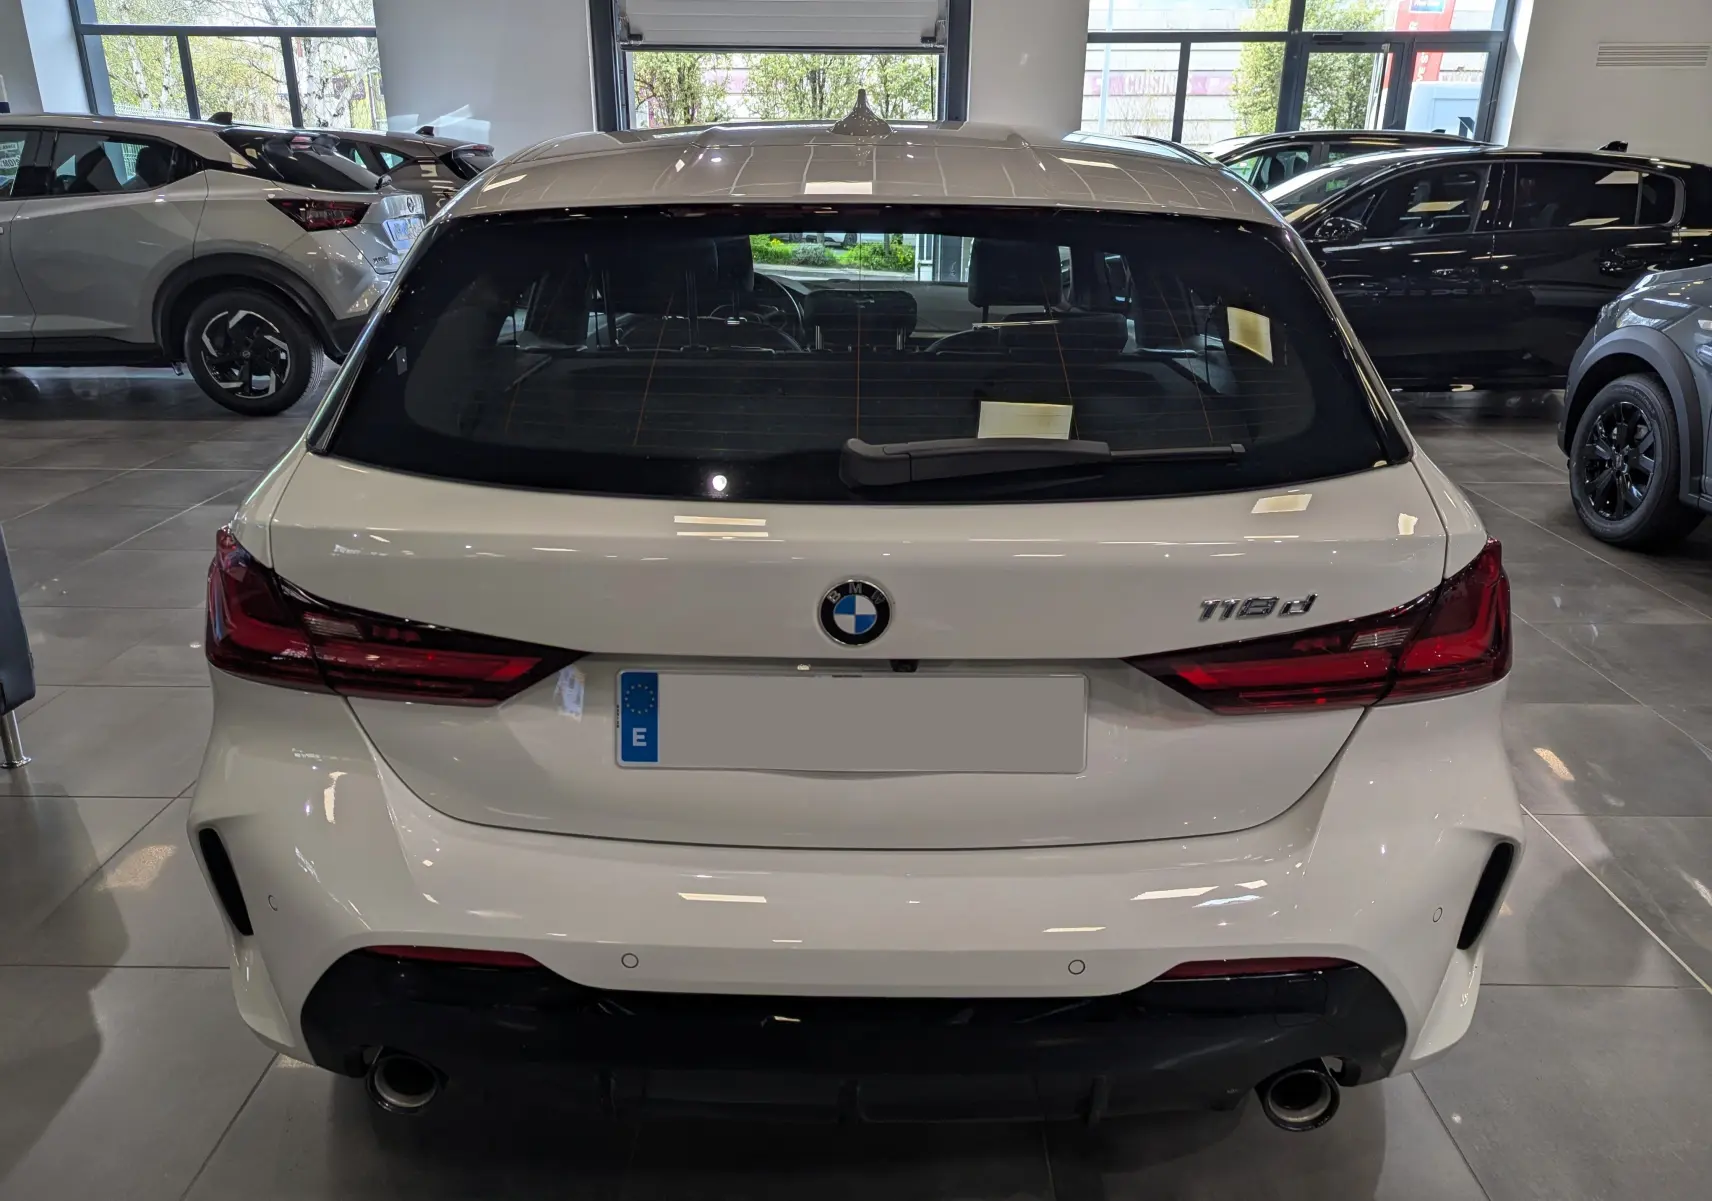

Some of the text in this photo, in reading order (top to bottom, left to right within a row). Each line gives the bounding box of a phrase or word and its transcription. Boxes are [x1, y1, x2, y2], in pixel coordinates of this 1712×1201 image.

[827, 582, 886, 604] BMW
[1199, 592, 1318, 620] 118d
[632, 727, 647, 747] E
